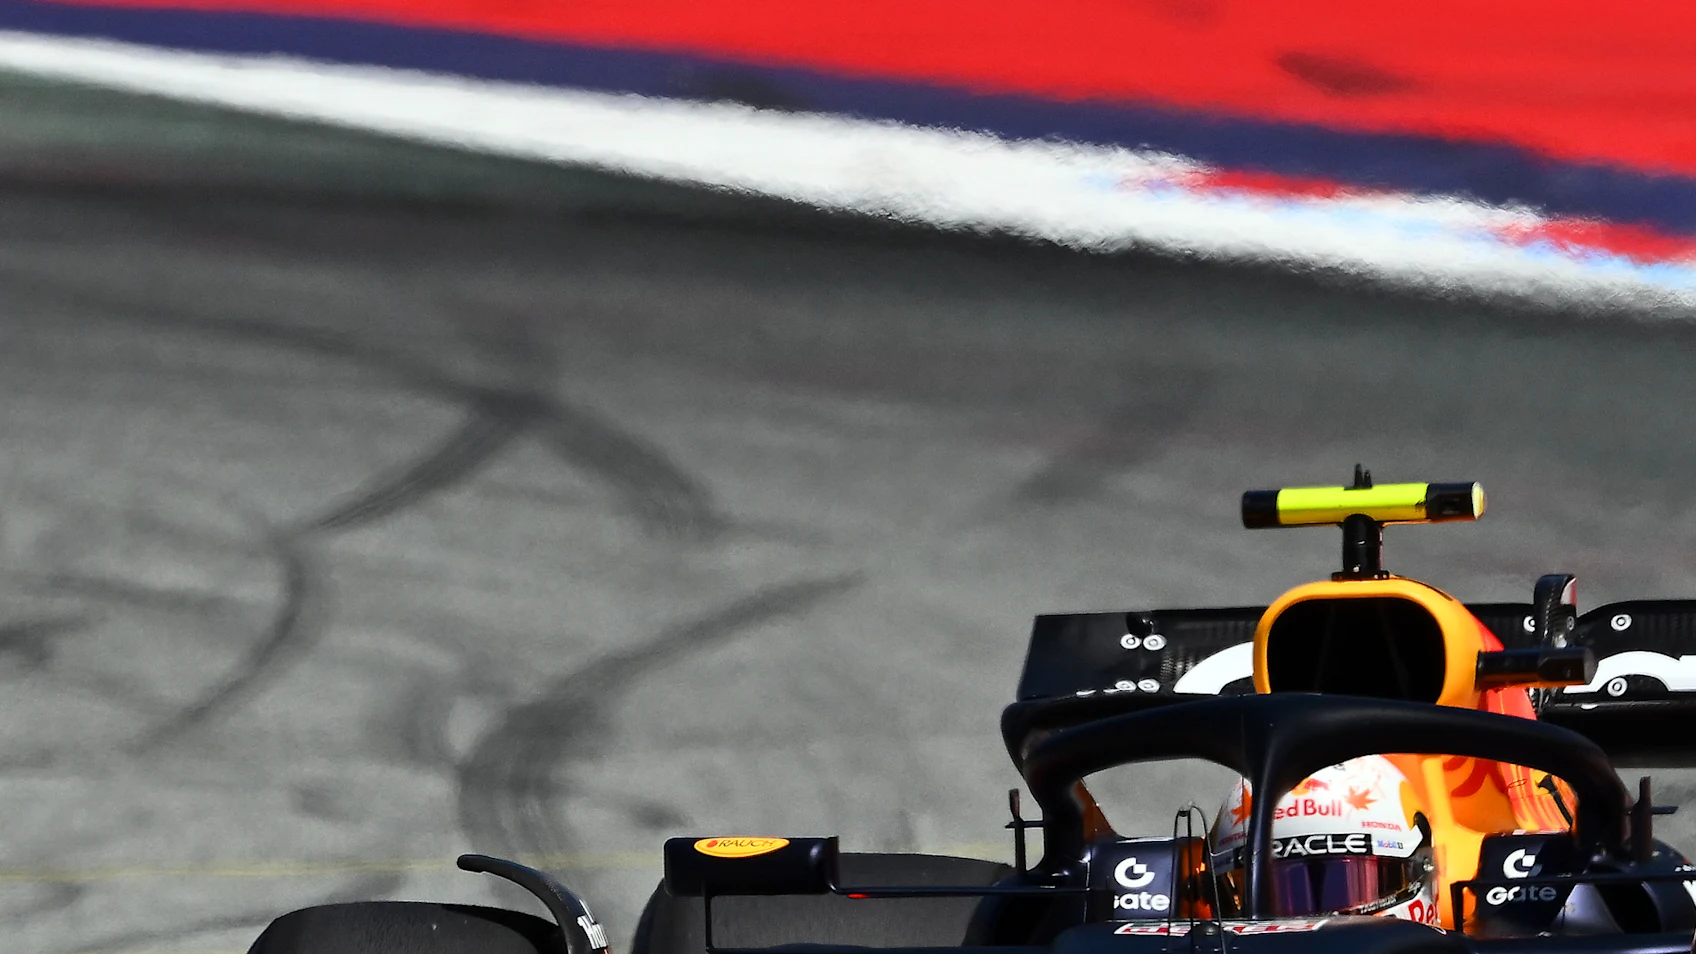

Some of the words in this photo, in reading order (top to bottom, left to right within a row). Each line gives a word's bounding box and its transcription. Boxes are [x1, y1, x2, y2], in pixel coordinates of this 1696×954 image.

[1273, 799, 1299, 820] ed
[1303, 799, 1342, 817] Bull
[1361, 821, 1402, 832] HONDA
[718, 838, 776, 848] RAUCH
[1272, 834, 1367, 858] RACLE
[1113, 891, 1171, 911] ate
[1486, 884, 1557, 906] Gate
